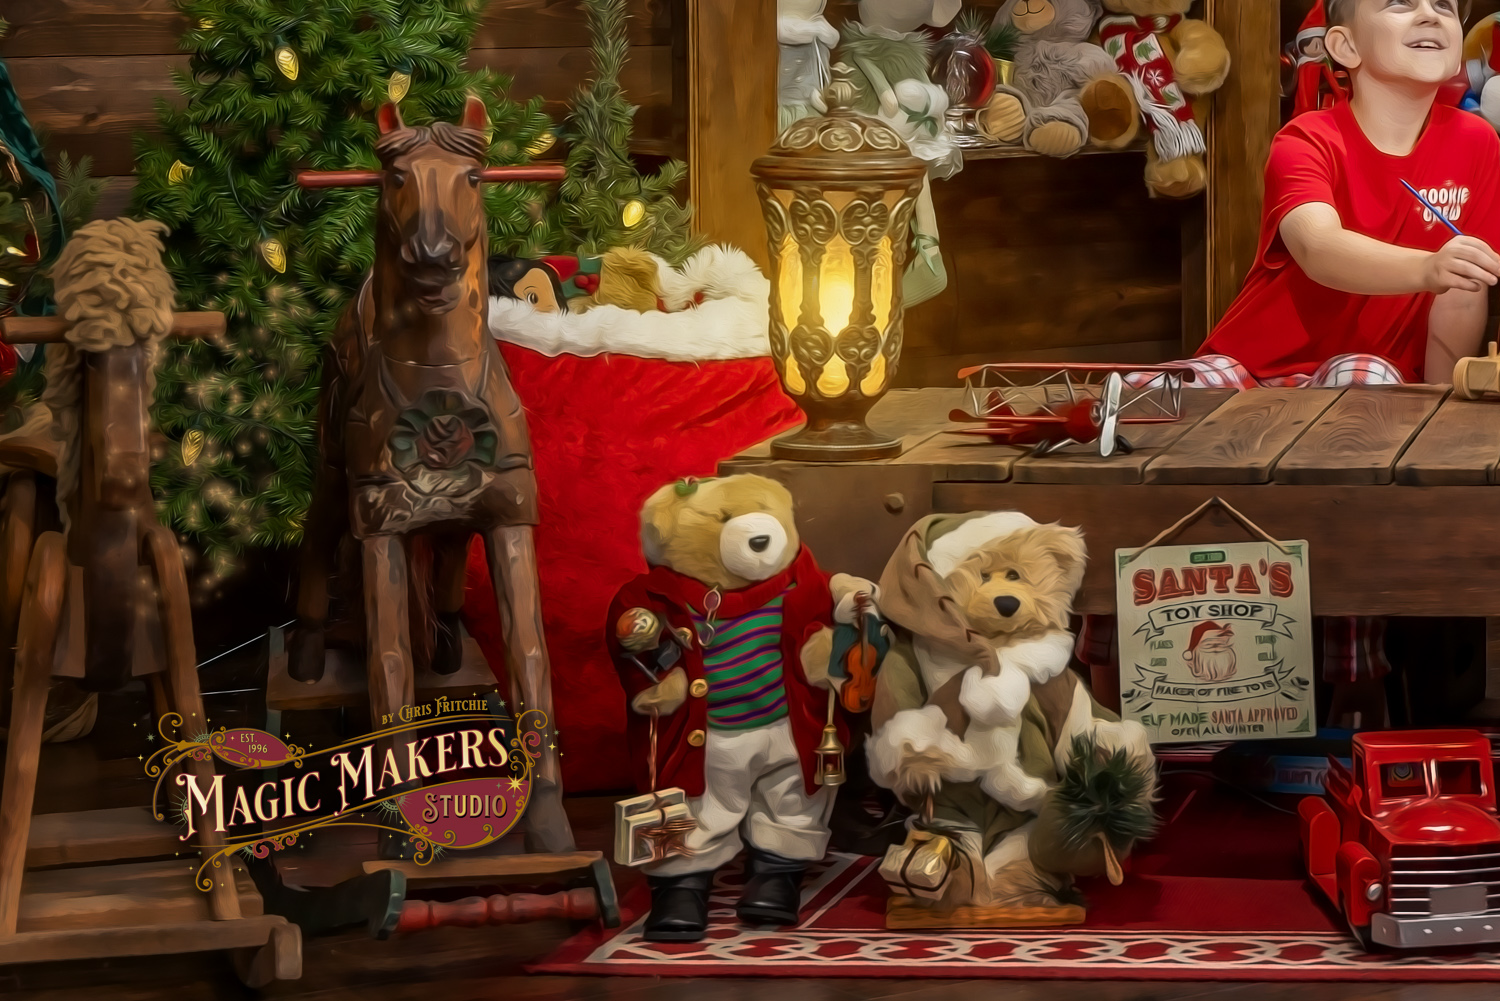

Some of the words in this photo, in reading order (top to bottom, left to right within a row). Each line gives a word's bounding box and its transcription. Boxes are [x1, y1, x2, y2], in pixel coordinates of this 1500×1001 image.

[1132, 558, 1294, 606] SANTA'S
[1159, 605, 1205, 622] TOY
[1207, 603, 1264, 618] SHOP
[1141, 713, 1167, 726] ELF
[1169, 711, 1209, 726] MADE
[1211, 709, 1244, 724] SANTA
[1247, 706, 1298, 723] APPROVED
[1171, 725, 1200, 737] OPEN
[1202, 725, 1222, 736] ALL
[1225, 724, 1265, 736] WINTER
